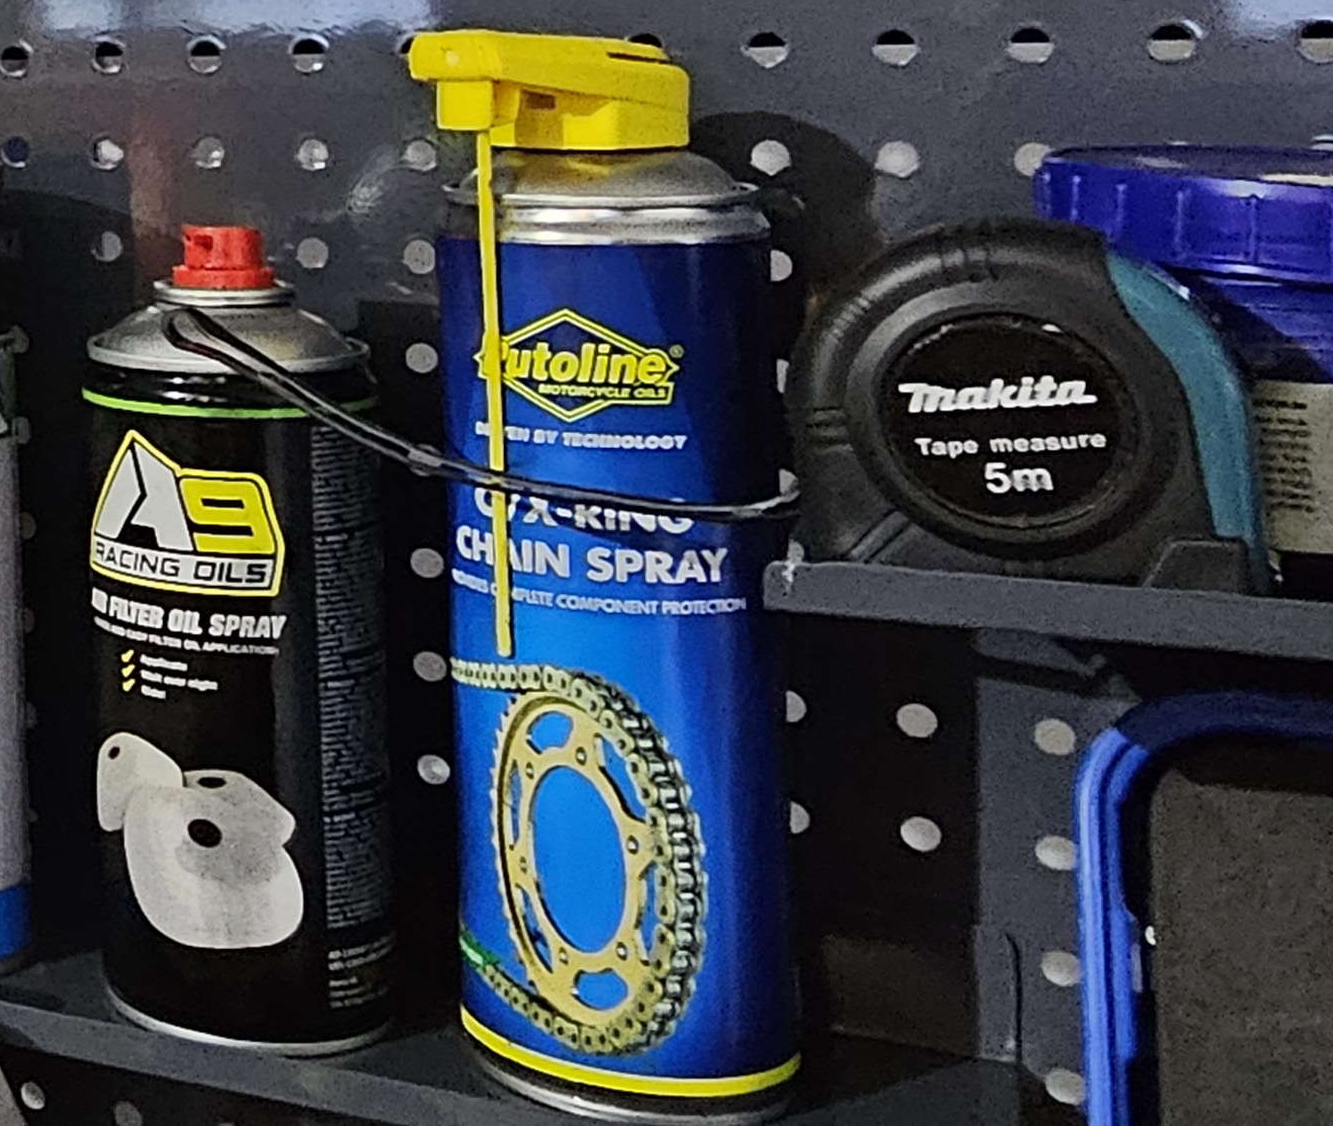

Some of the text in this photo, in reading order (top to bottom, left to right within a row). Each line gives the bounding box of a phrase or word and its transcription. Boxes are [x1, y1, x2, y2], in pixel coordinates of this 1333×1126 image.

[538, 383, 666, 399] MOTORCYCLE OILS
[532, 428, 688, 451] BY TECHNOLOGY
[913, 431, 1108, 459] Tape measure
[984, 462, 1054, 495] 5m
[94, 444, 276, 554] A9
[95, 540, 268, 584] RACING OILS
[586, 546, 729, 585] SPRAY
[109, 595, 287, 640] FILTER OIL SPRAY
[555, 592, 747, 617] COMPONENT PROTECTION
[148, 632, 182, 649] FILTER
[183, 638, 201, 652] OIL
